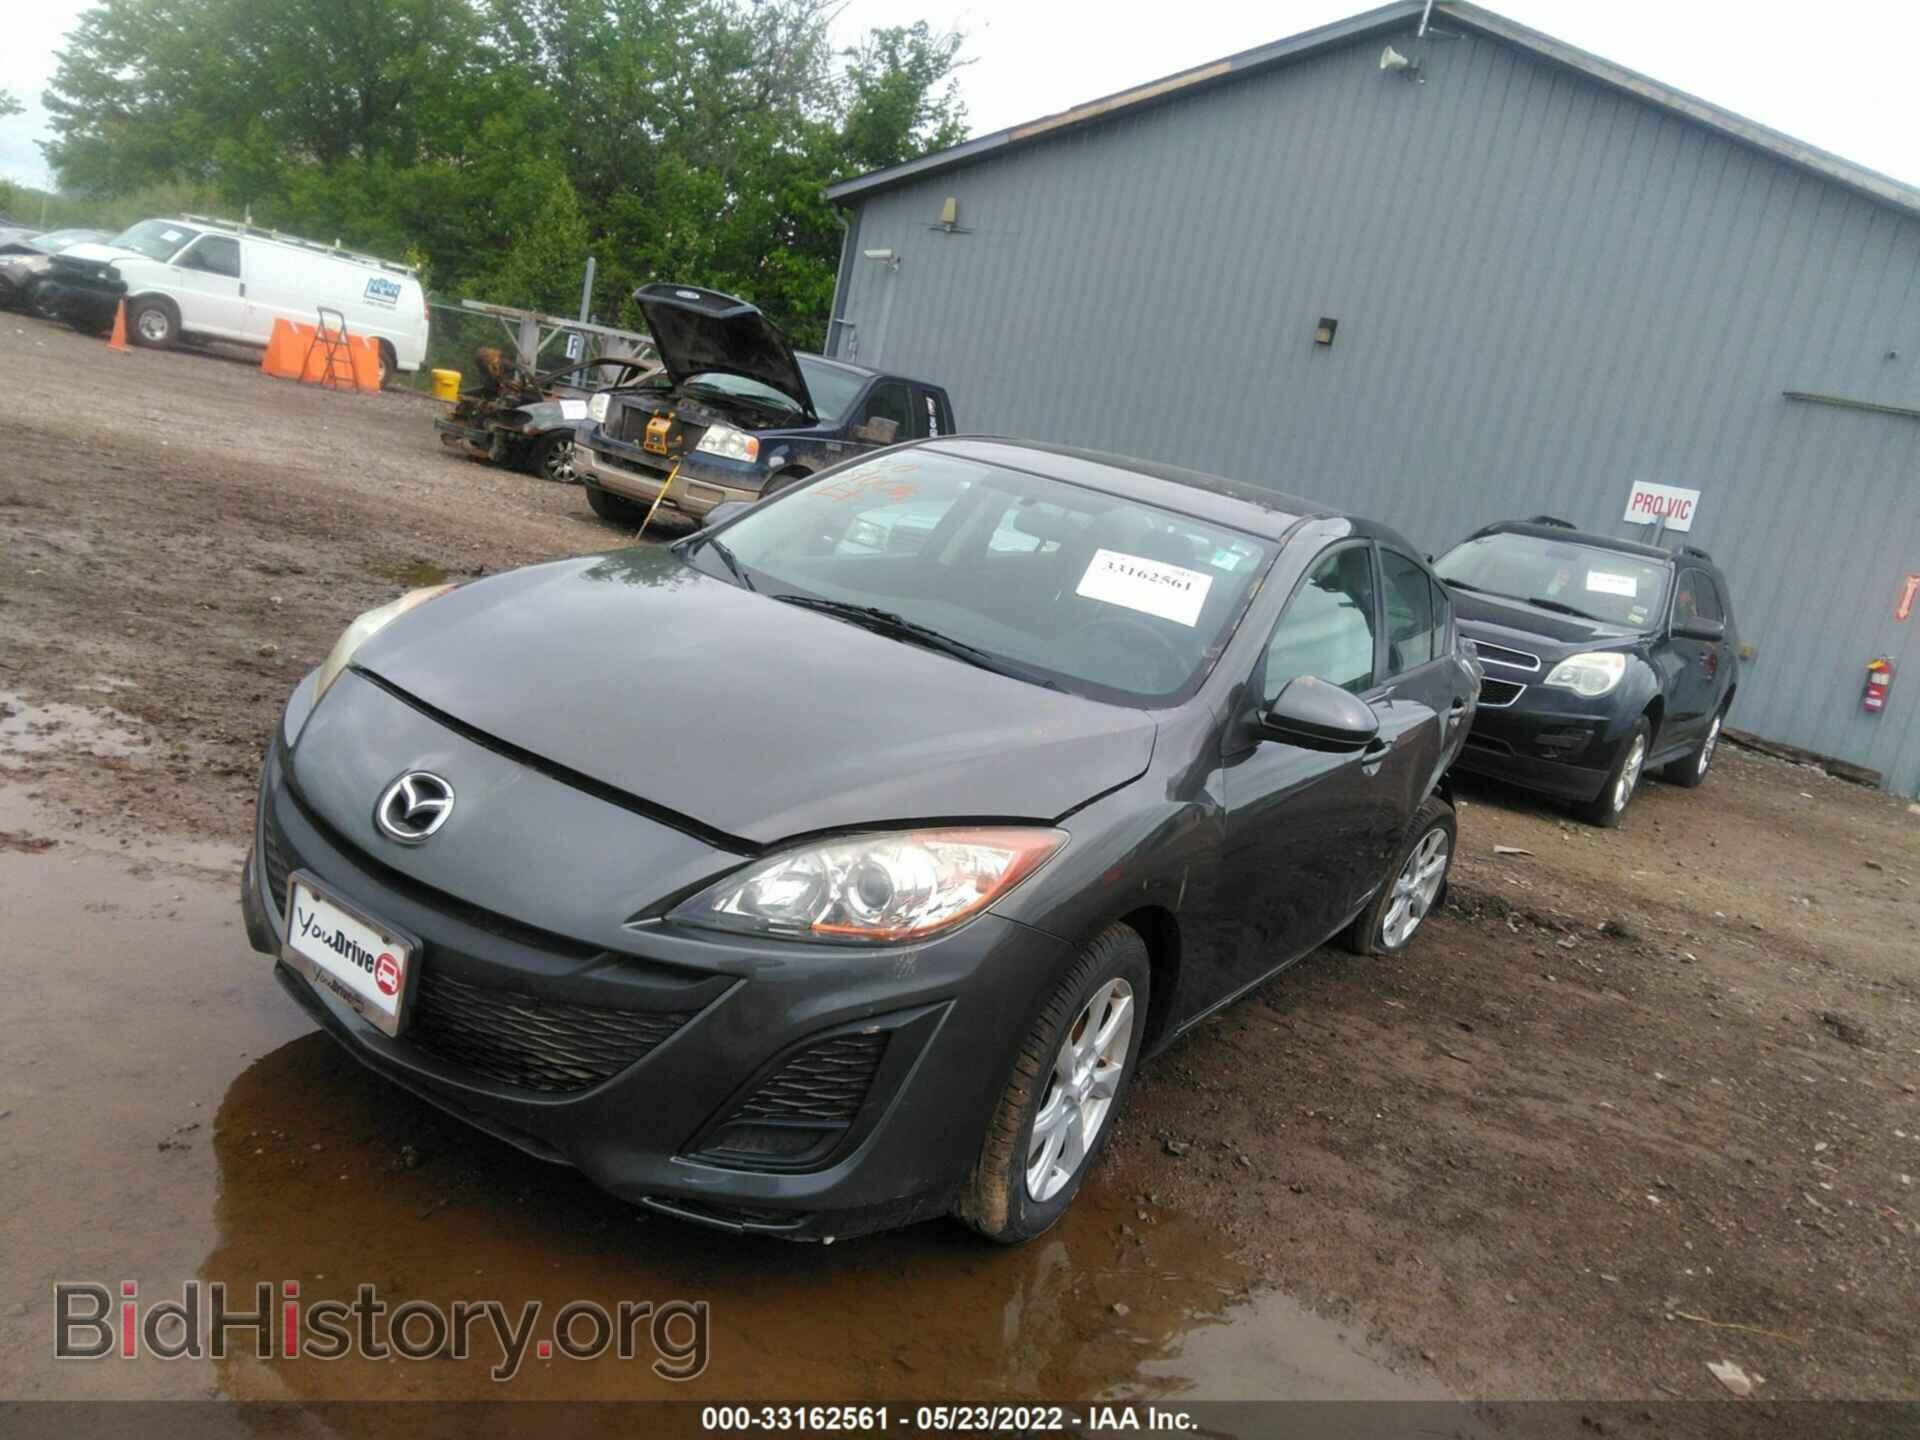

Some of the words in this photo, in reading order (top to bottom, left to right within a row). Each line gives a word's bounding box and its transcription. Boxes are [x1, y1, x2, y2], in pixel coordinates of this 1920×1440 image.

[1631, 492, 1662, 516] PRO
[1666, 497, 1693, 521] VIC
[1102, 560, 1193, 591] 33162561
[298, 906, 375, 973] YouDrive
